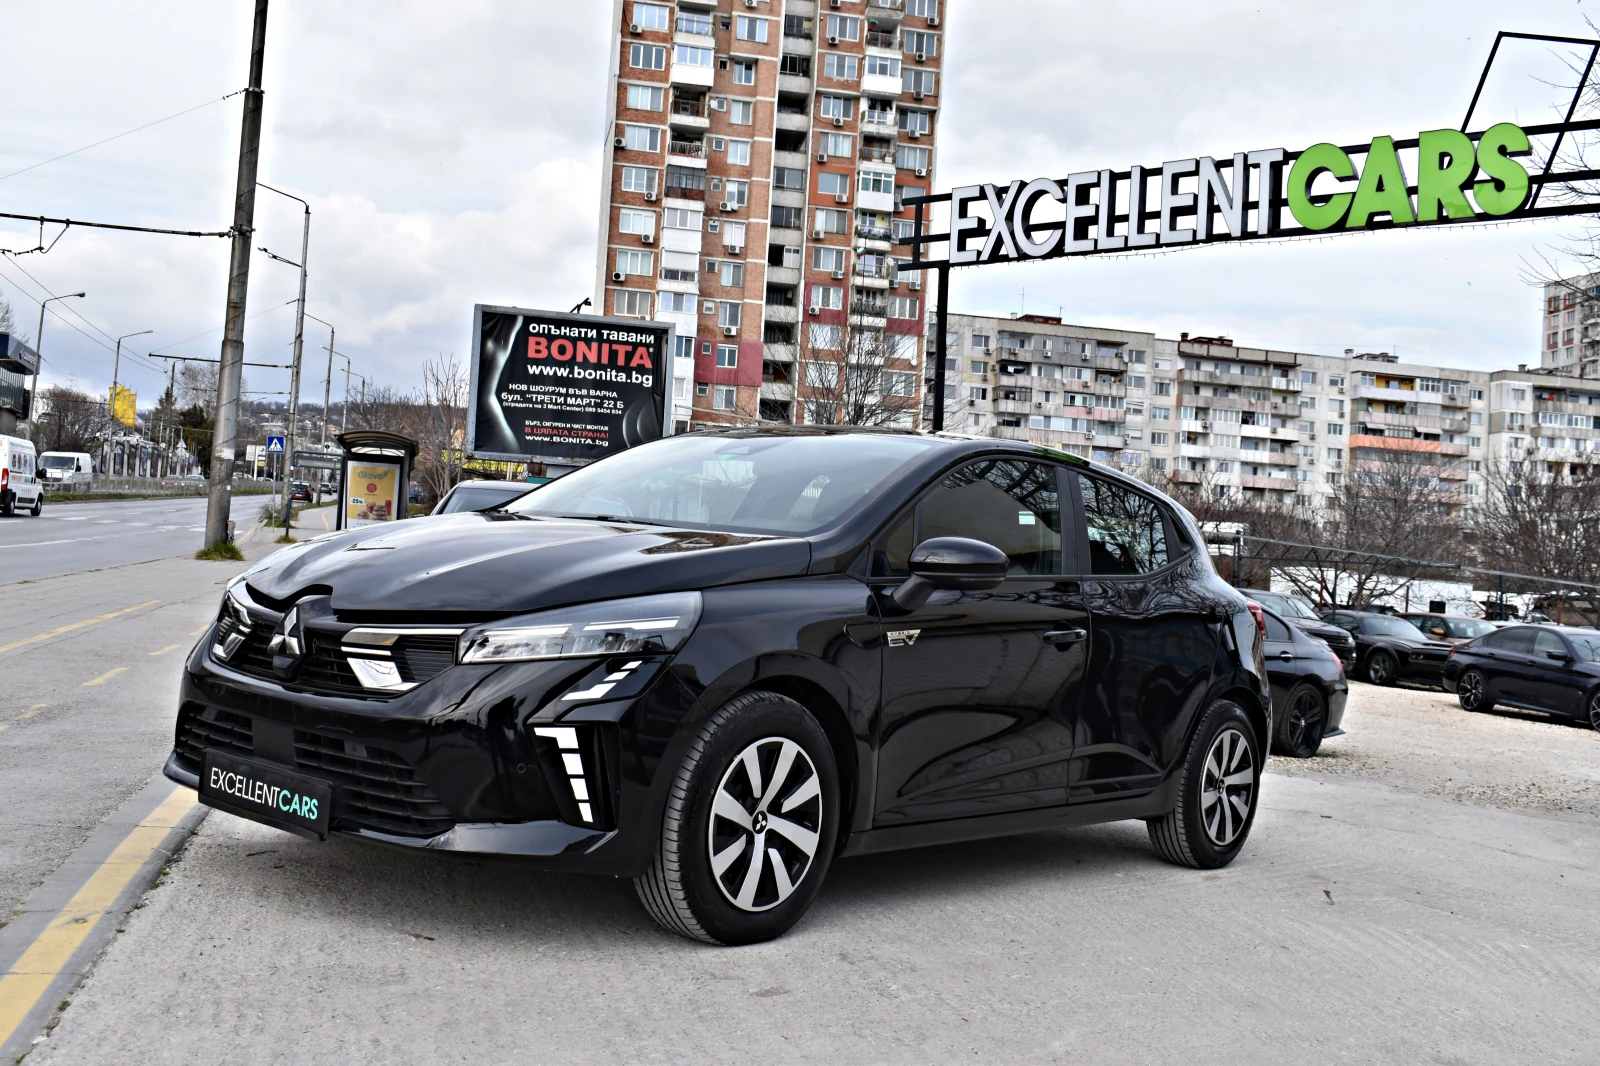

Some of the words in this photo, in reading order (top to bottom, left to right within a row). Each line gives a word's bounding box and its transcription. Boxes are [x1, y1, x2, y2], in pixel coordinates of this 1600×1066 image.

[529, 323, 597, 339] опънати
[601, 329, 654, 344] тавани
[527, 336, 653, 368] BONITA
[527, 364, 653, 387] www.bonita.bg
[501, 392, 523, 401] бул.
[530, 385, 566, 394] ШОУРУМ
[590, 390, 618, 398] ВАРНА
[534, 427, 569, 436] ЦЯЛАТА
[525, 436, 608, 446] www.BONITA.bg
[358, 470, 384, 480] Glovo
